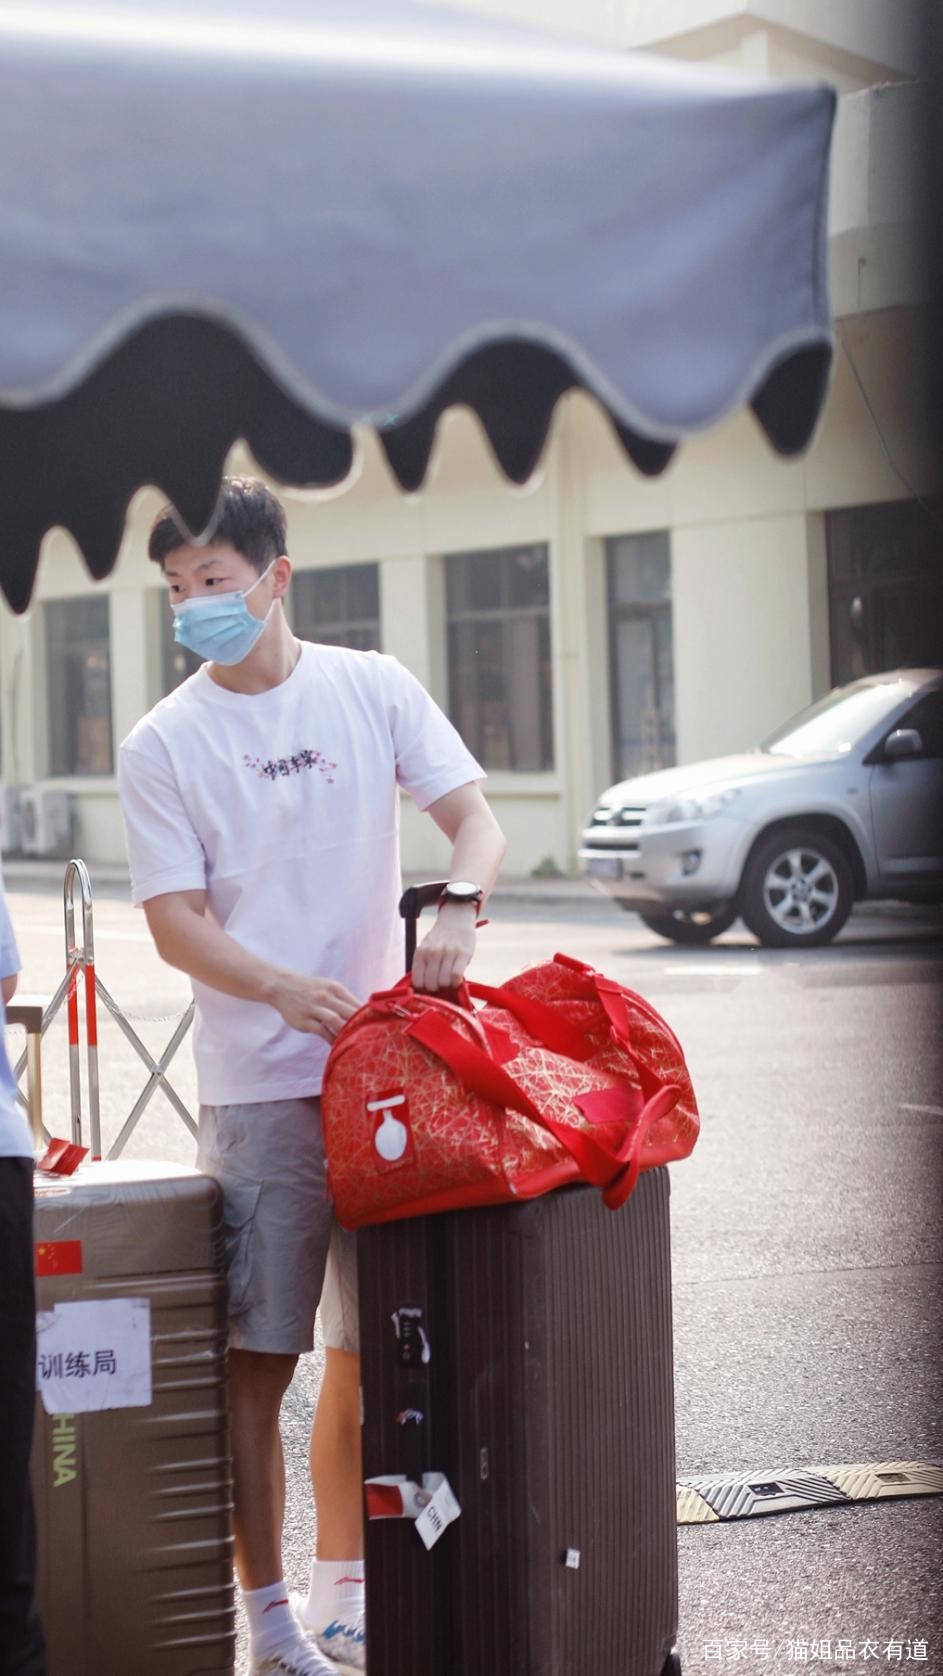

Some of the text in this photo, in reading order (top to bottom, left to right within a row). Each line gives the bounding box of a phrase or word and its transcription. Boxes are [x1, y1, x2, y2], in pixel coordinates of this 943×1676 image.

[38, 1350, 116, 1379] 训练局
[53, 1413, 77, 1487] HINA
[427, 1506, 442, 1533] CHN
